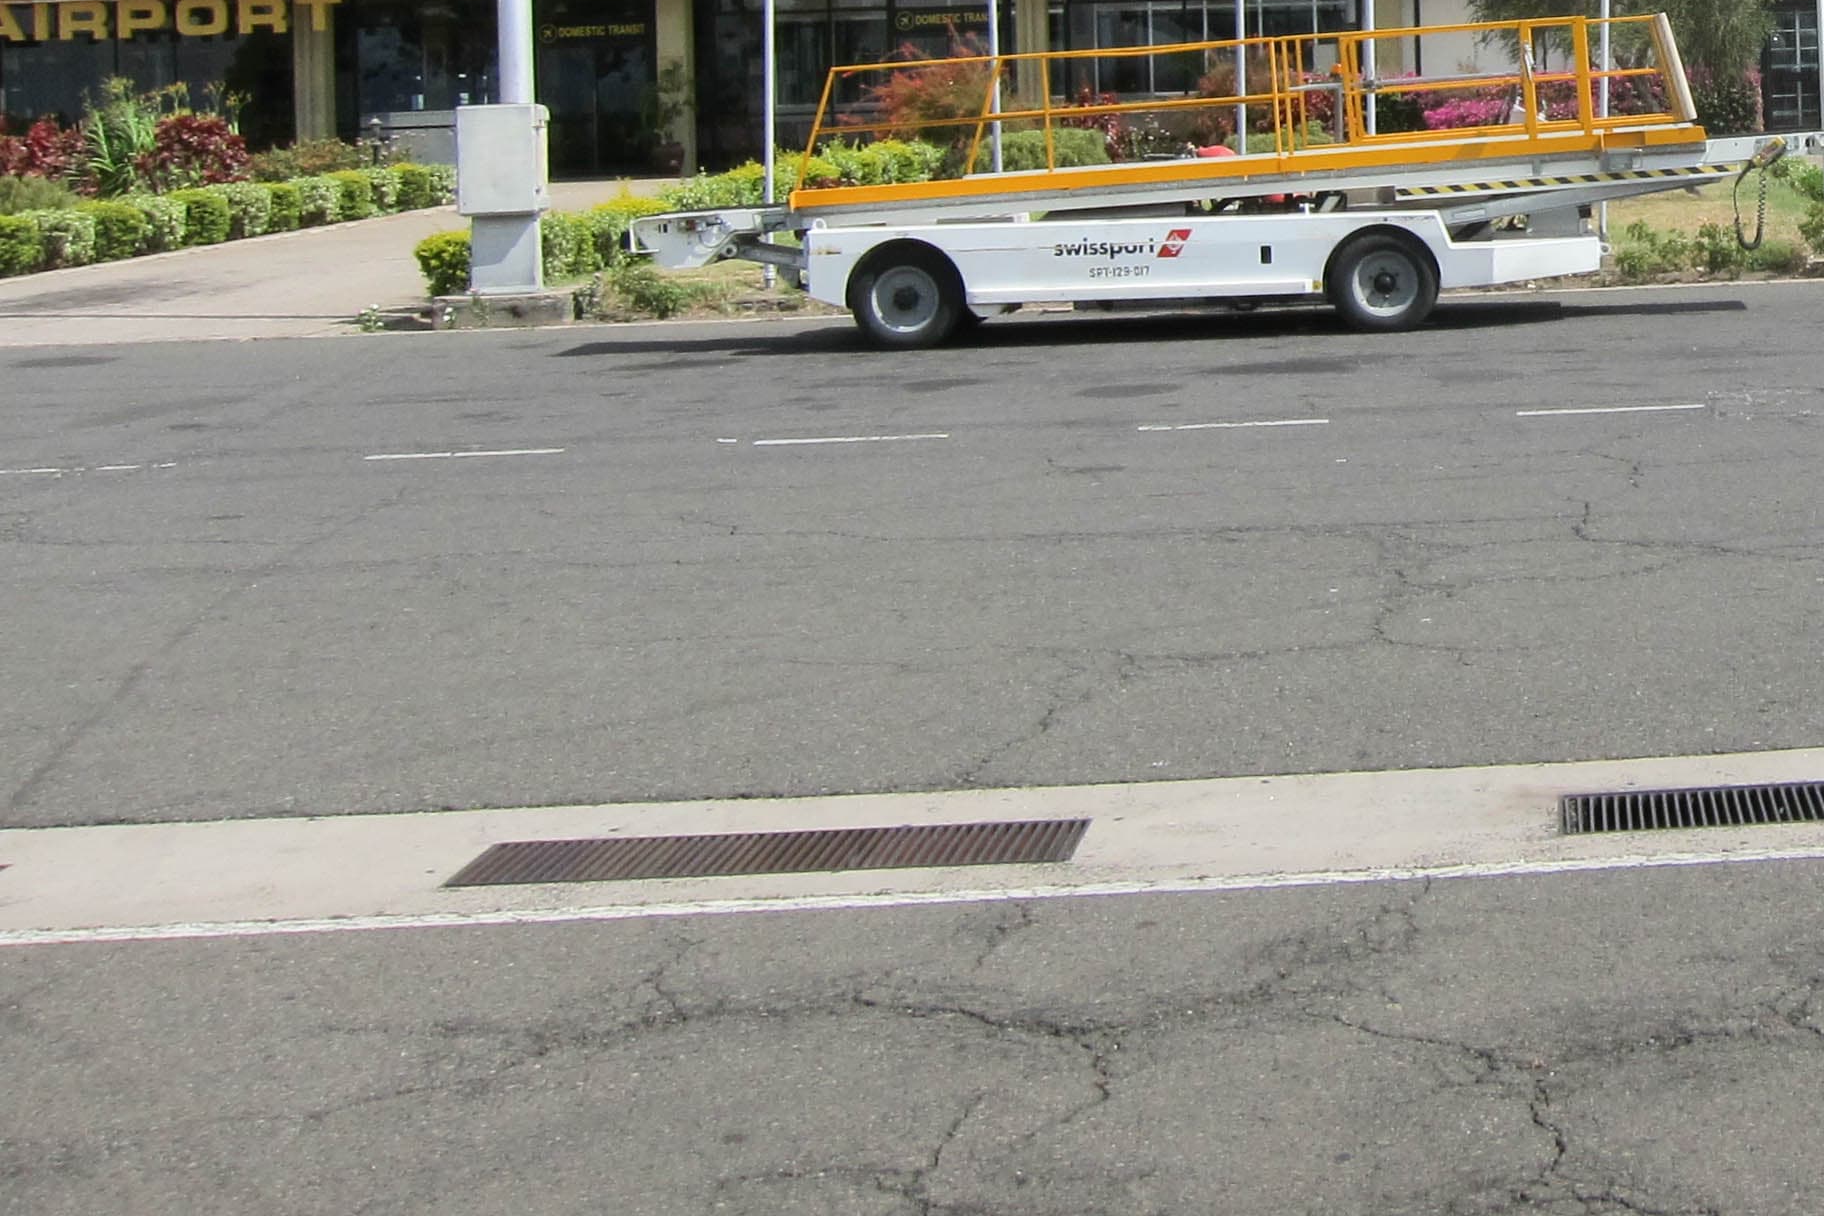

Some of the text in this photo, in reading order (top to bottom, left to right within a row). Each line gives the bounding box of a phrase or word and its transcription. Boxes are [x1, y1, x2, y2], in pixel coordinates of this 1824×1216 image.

[915, 14, 961, 25] DOMESTIC
[559, 23, 645, 37] DOMESTIC TRANSIT
